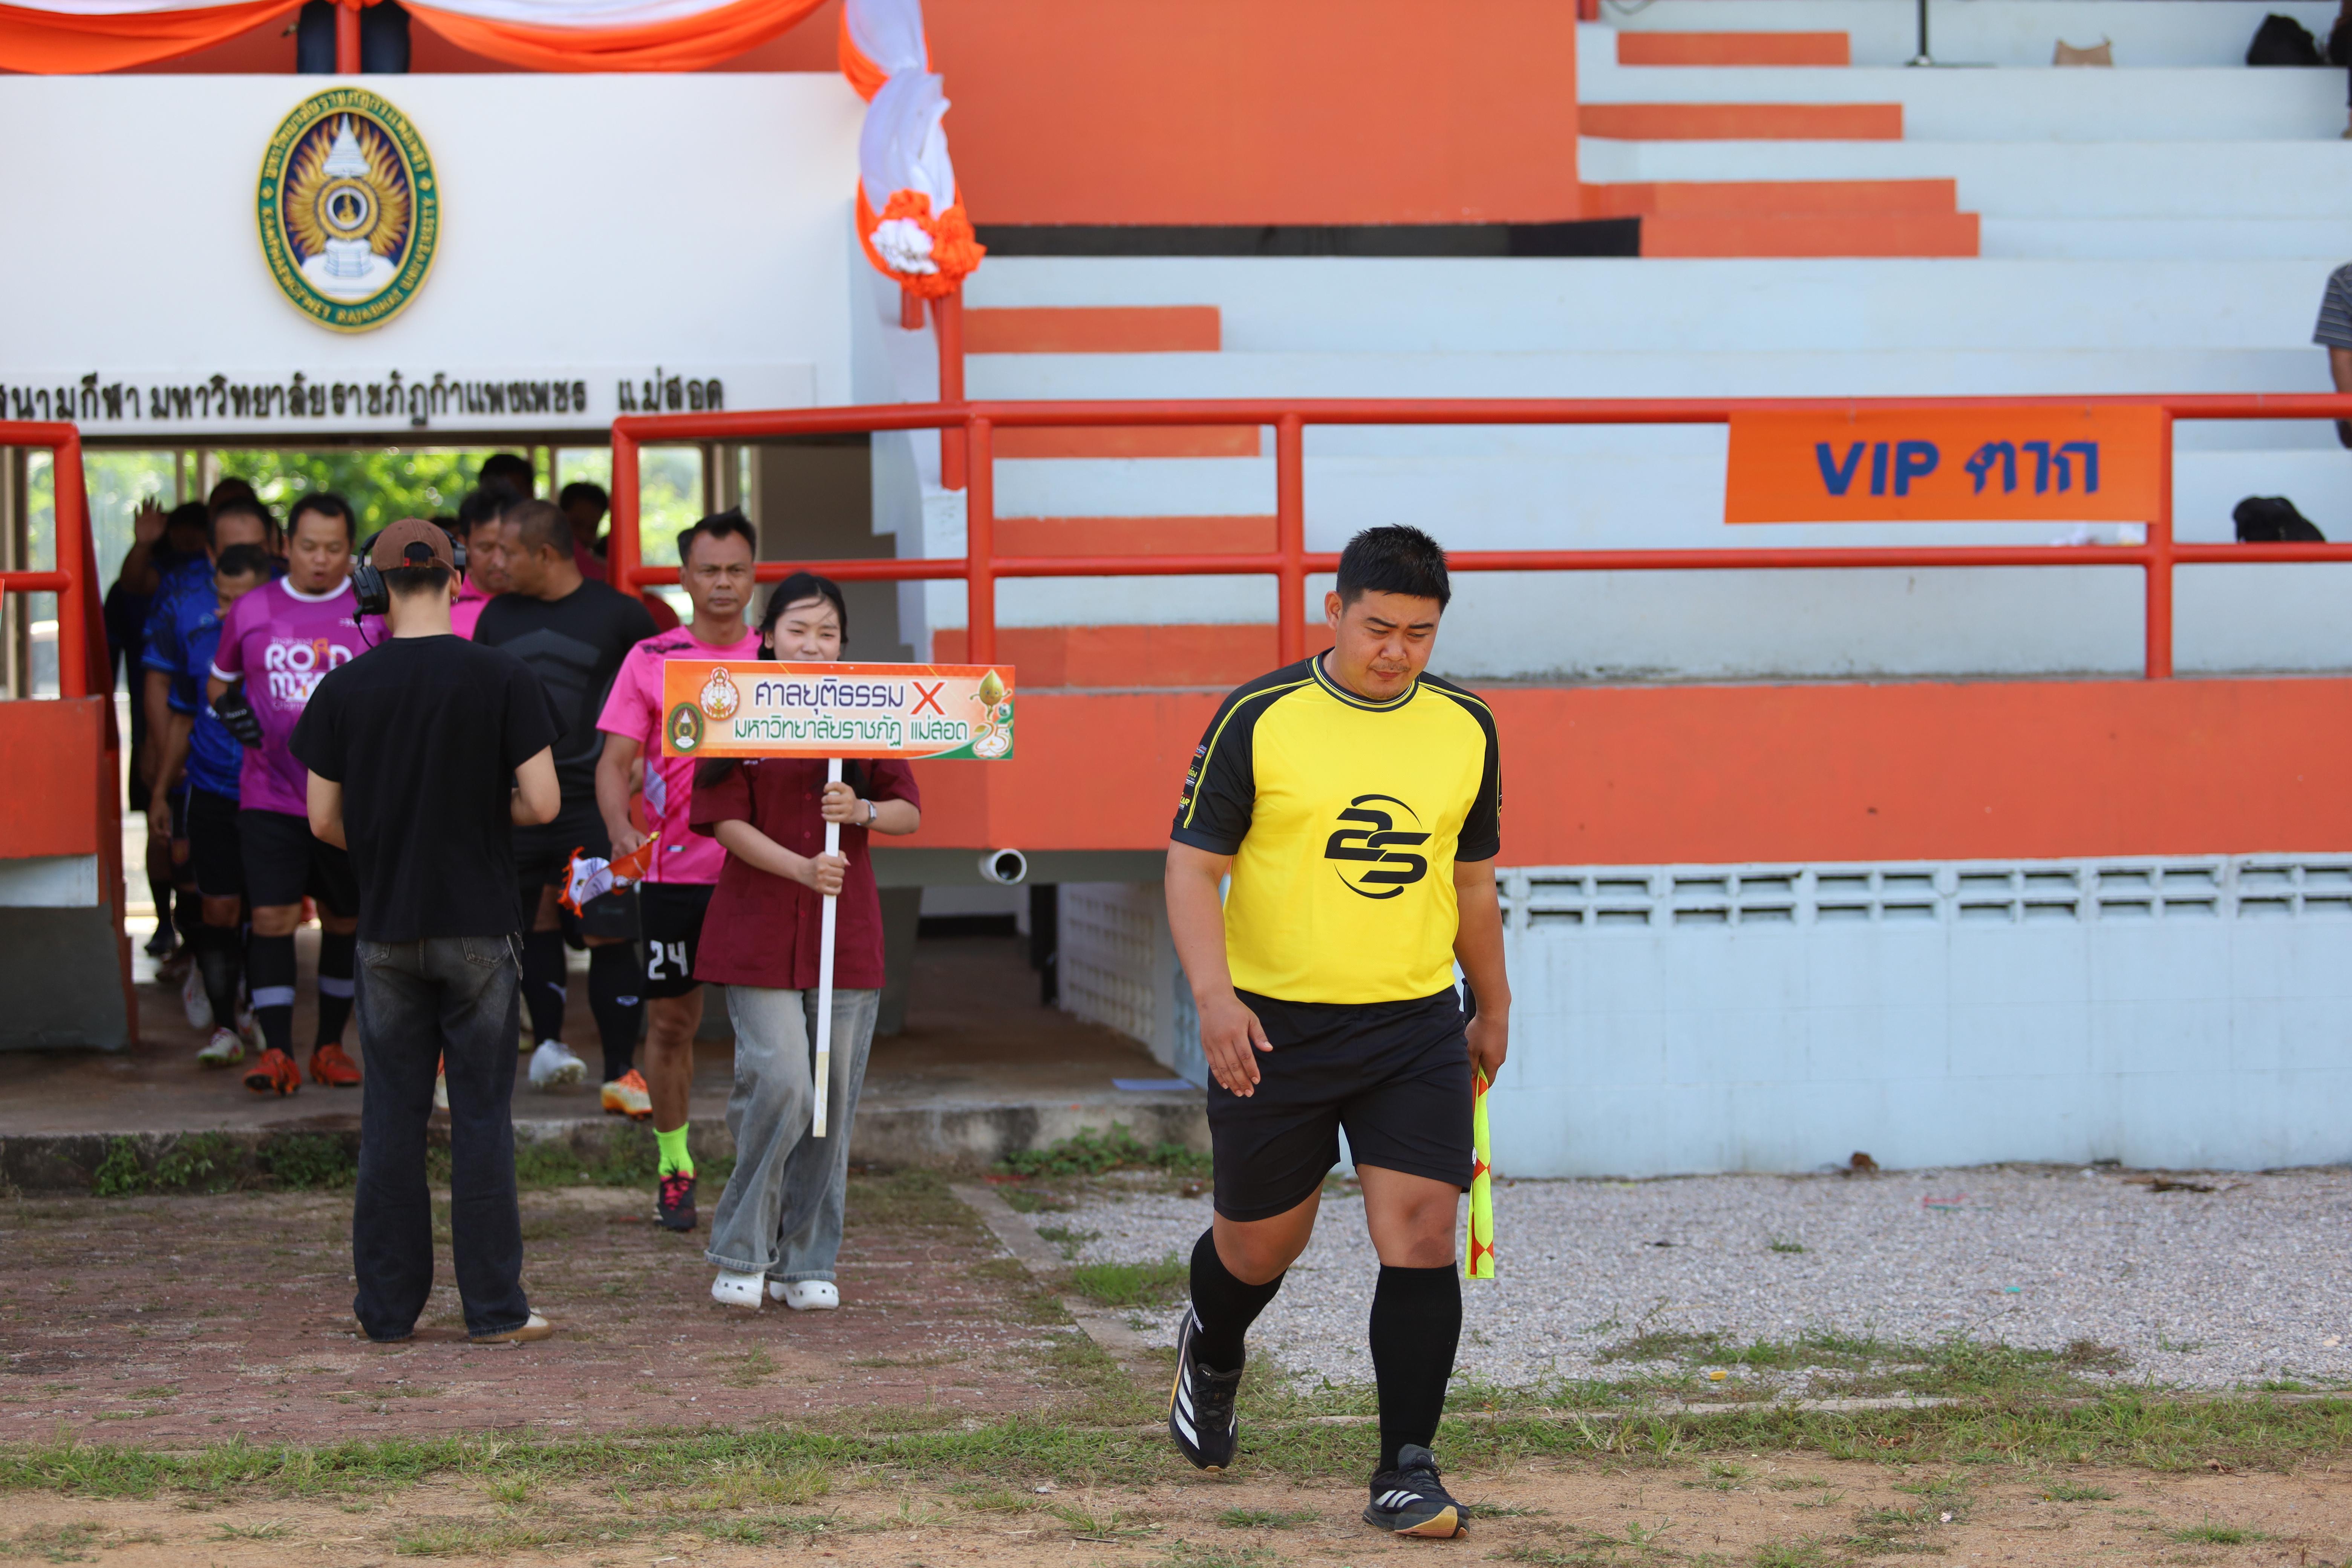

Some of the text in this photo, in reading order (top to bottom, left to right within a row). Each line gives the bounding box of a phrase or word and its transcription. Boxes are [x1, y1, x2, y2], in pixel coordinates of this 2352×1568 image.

[336, 289, 403, 324] RAJABHAT
[400, 196, 435, 291] UNIVERSITY
[618, 366, 723, 411] แม่สอด
[1815, 439, 2099, 497] VIP ตาก
[755, 678, 946, 715] ศาลยุติธรรม X
[735, 715, 968, 747] มหาวิทยาลัยราชภัฏ แม่สอด
[648, 940, 688, 980] 24
